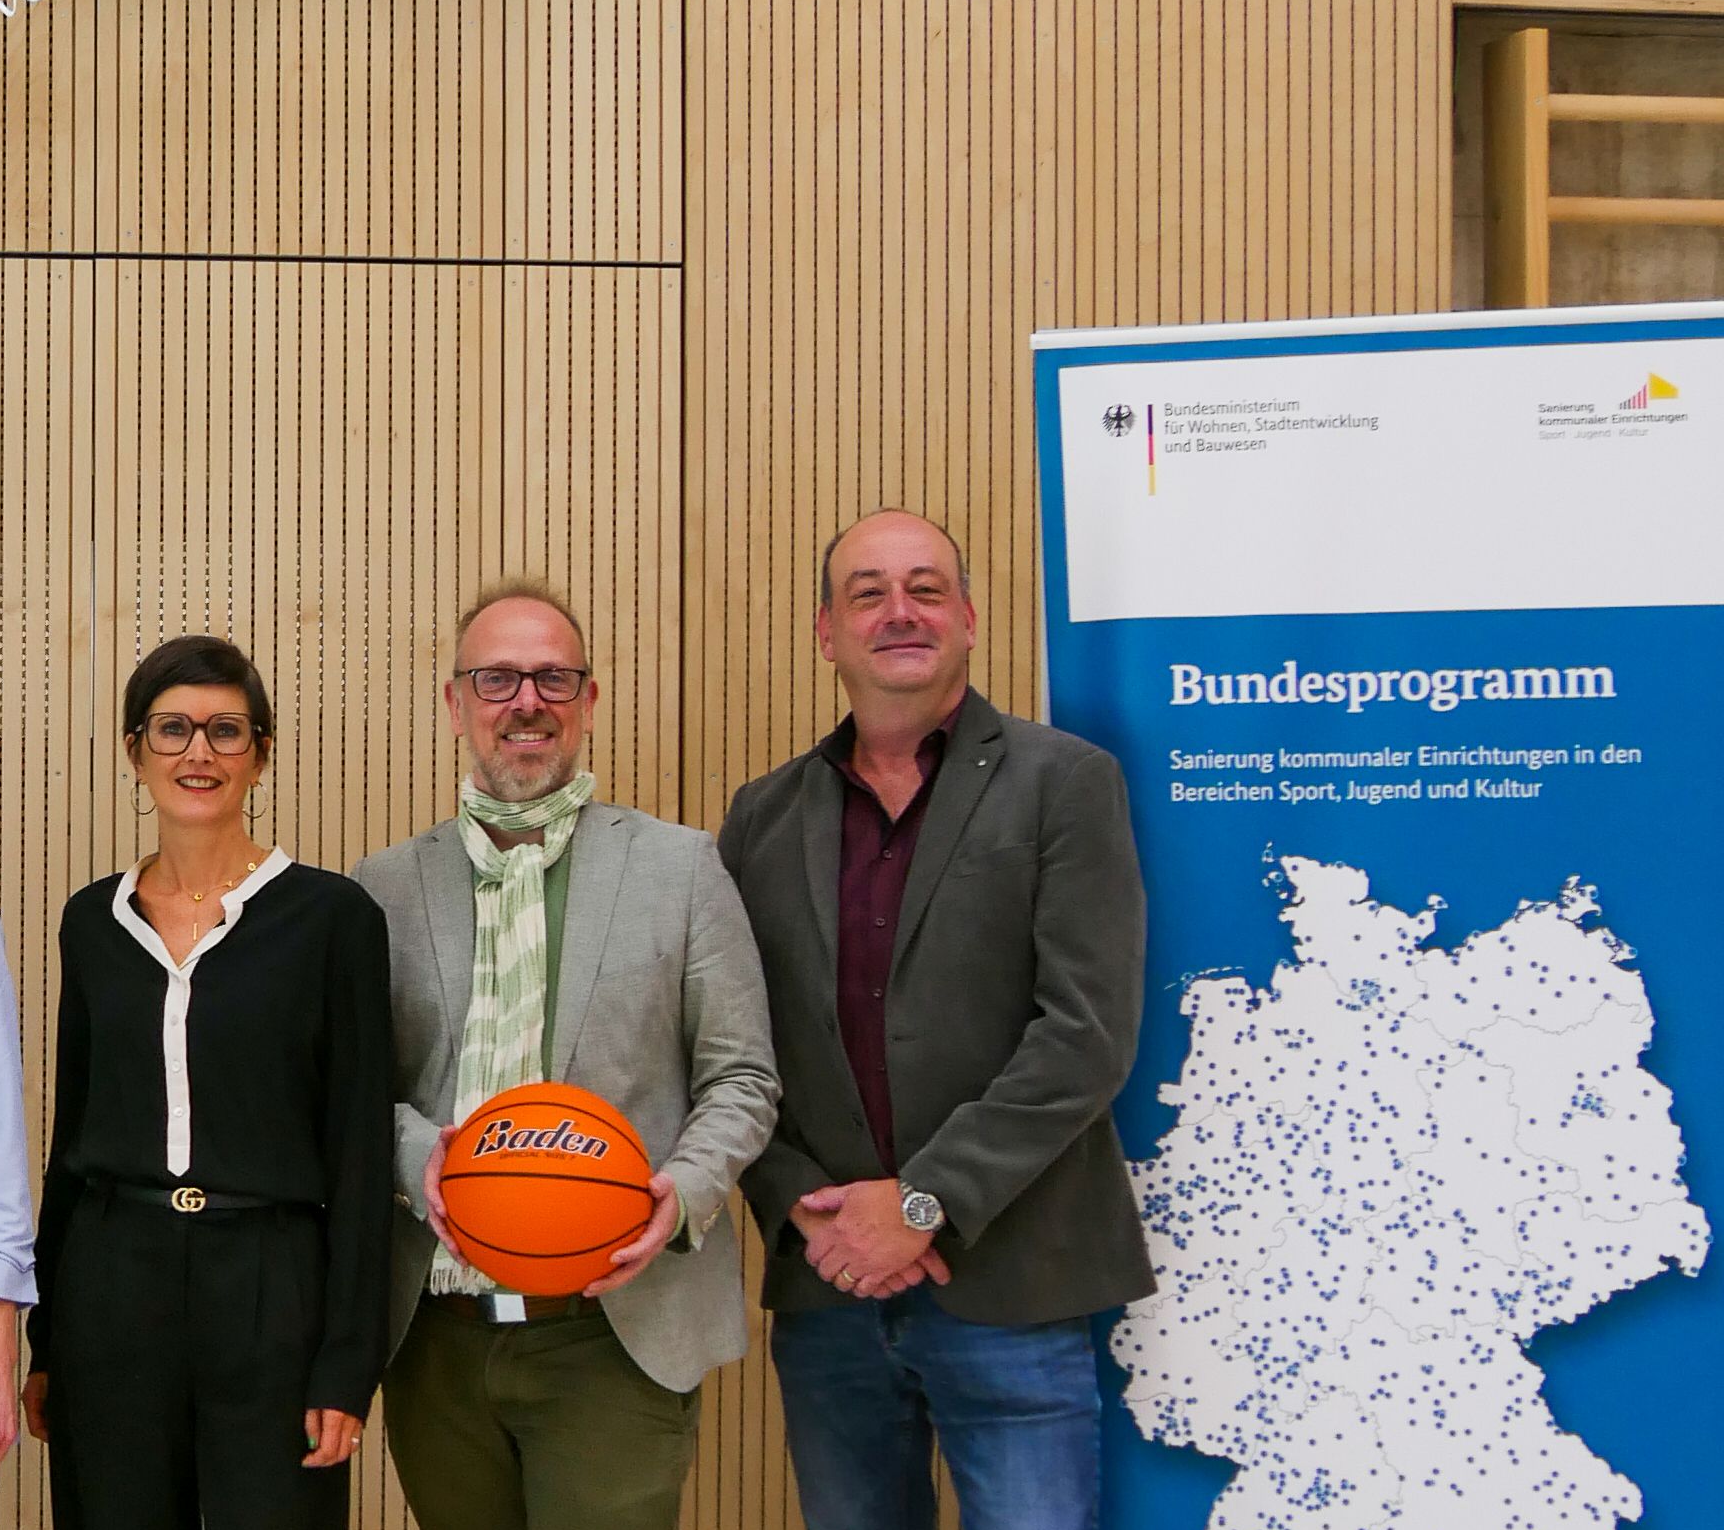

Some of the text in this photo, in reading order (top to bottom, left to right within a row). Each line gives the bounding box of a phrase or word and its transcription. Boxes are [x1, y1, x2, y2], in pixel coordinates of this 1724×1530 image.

[1164, 399, 1300, 417] Bundesministerium
[1538, 403, 1595, 414] Sanierung
[1164, 414, 1379, 436] für Wohnen, Stadtentwicklung
[1538, 413, 1688, 426] kommunaler Einrichtungen
[1165, 437, 1267, 453] und Bauwesen
[1169, 660, 1617, 713] Bundesprogramm
[1169, 744, 1642, 773] Sanierung kommunaler Einrichtungen in den
[1171, 777, 1543, 805] Bereichen Sport, Jugend und Kultur
[472, 1119, 610, 1160] Baden
